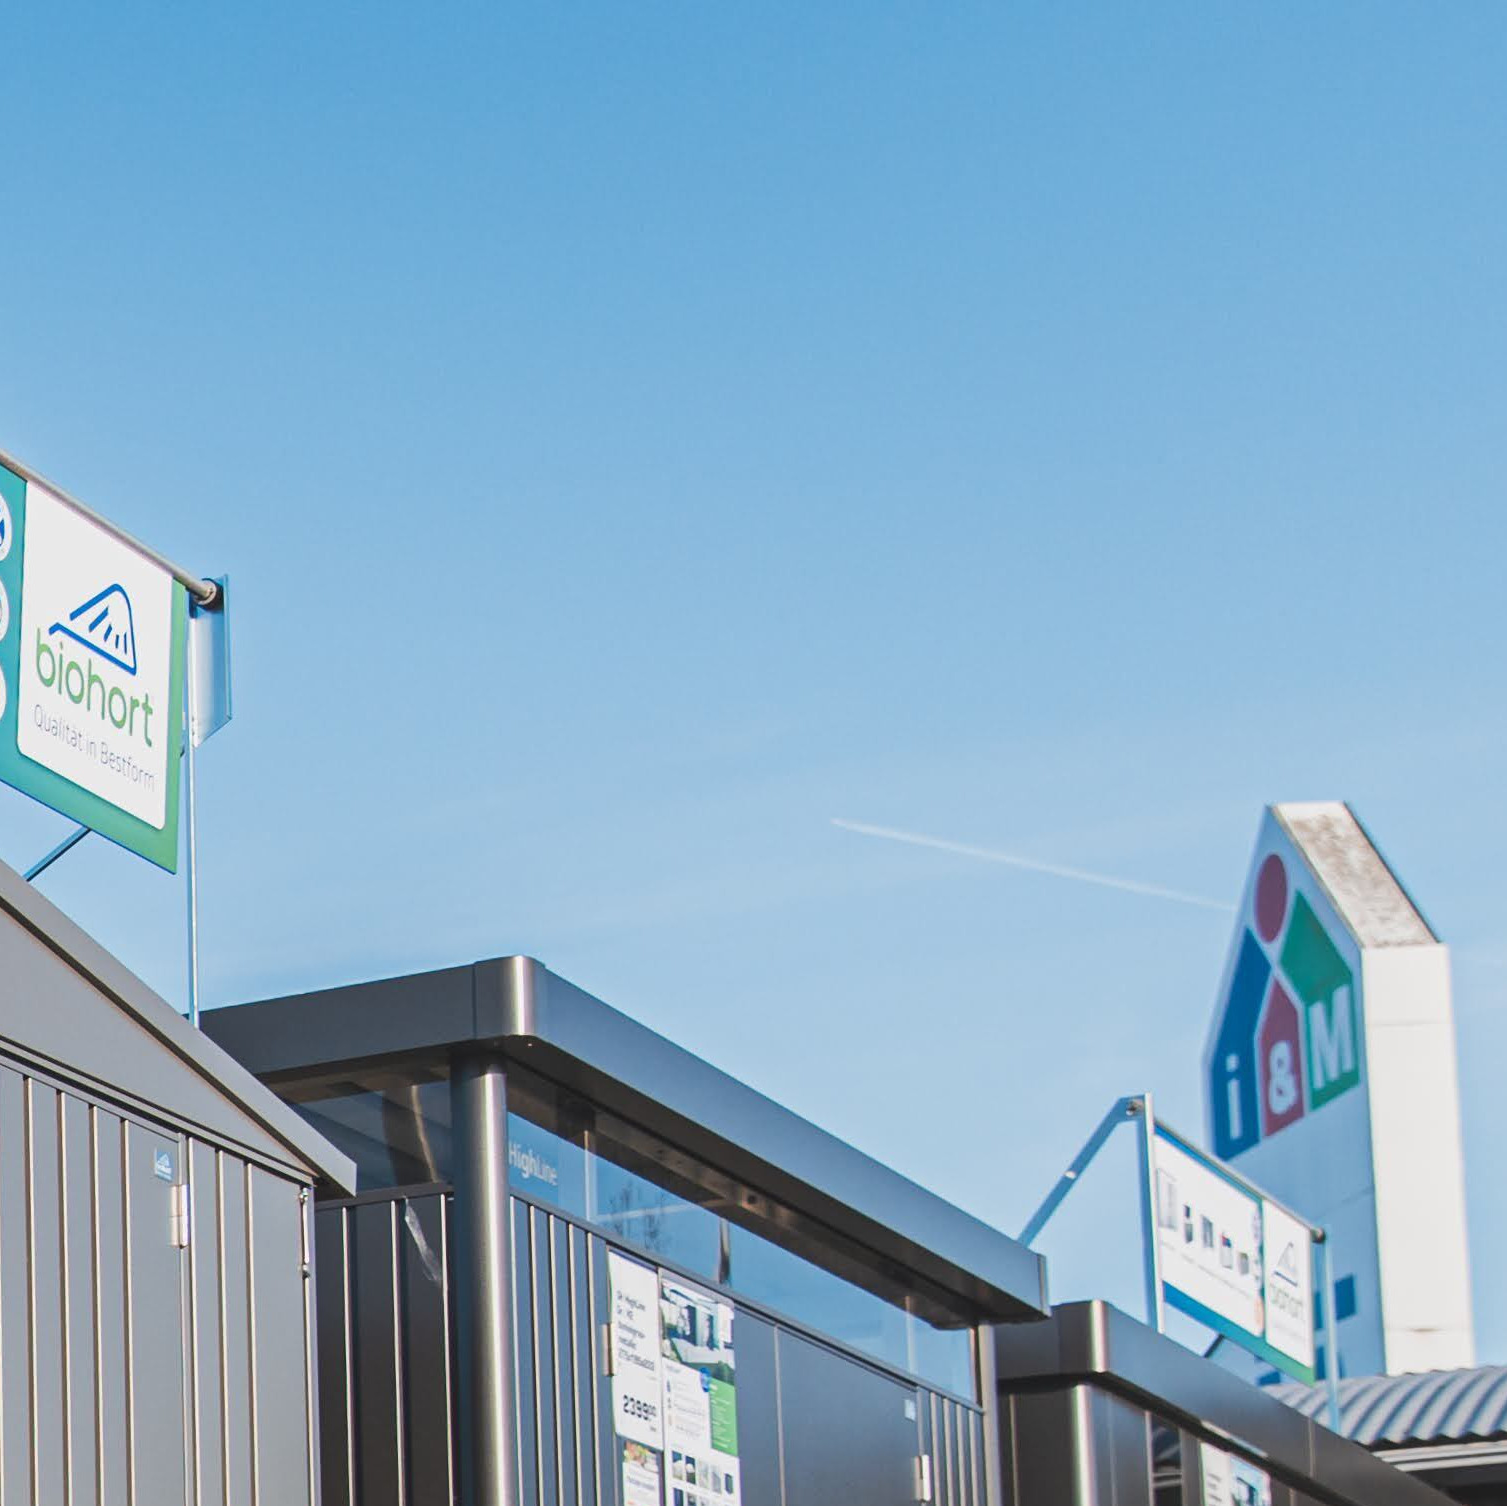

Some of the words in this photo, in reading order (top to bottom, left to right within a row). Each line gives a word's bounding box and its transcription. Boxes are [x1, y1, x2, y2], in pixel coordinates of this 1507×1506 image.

[36, 627, 153, 748] biohort
[34, 703, 83, 752] Qualität
[86, 740, 97, 760] in
[100, 741, 155, 793] Bestform
